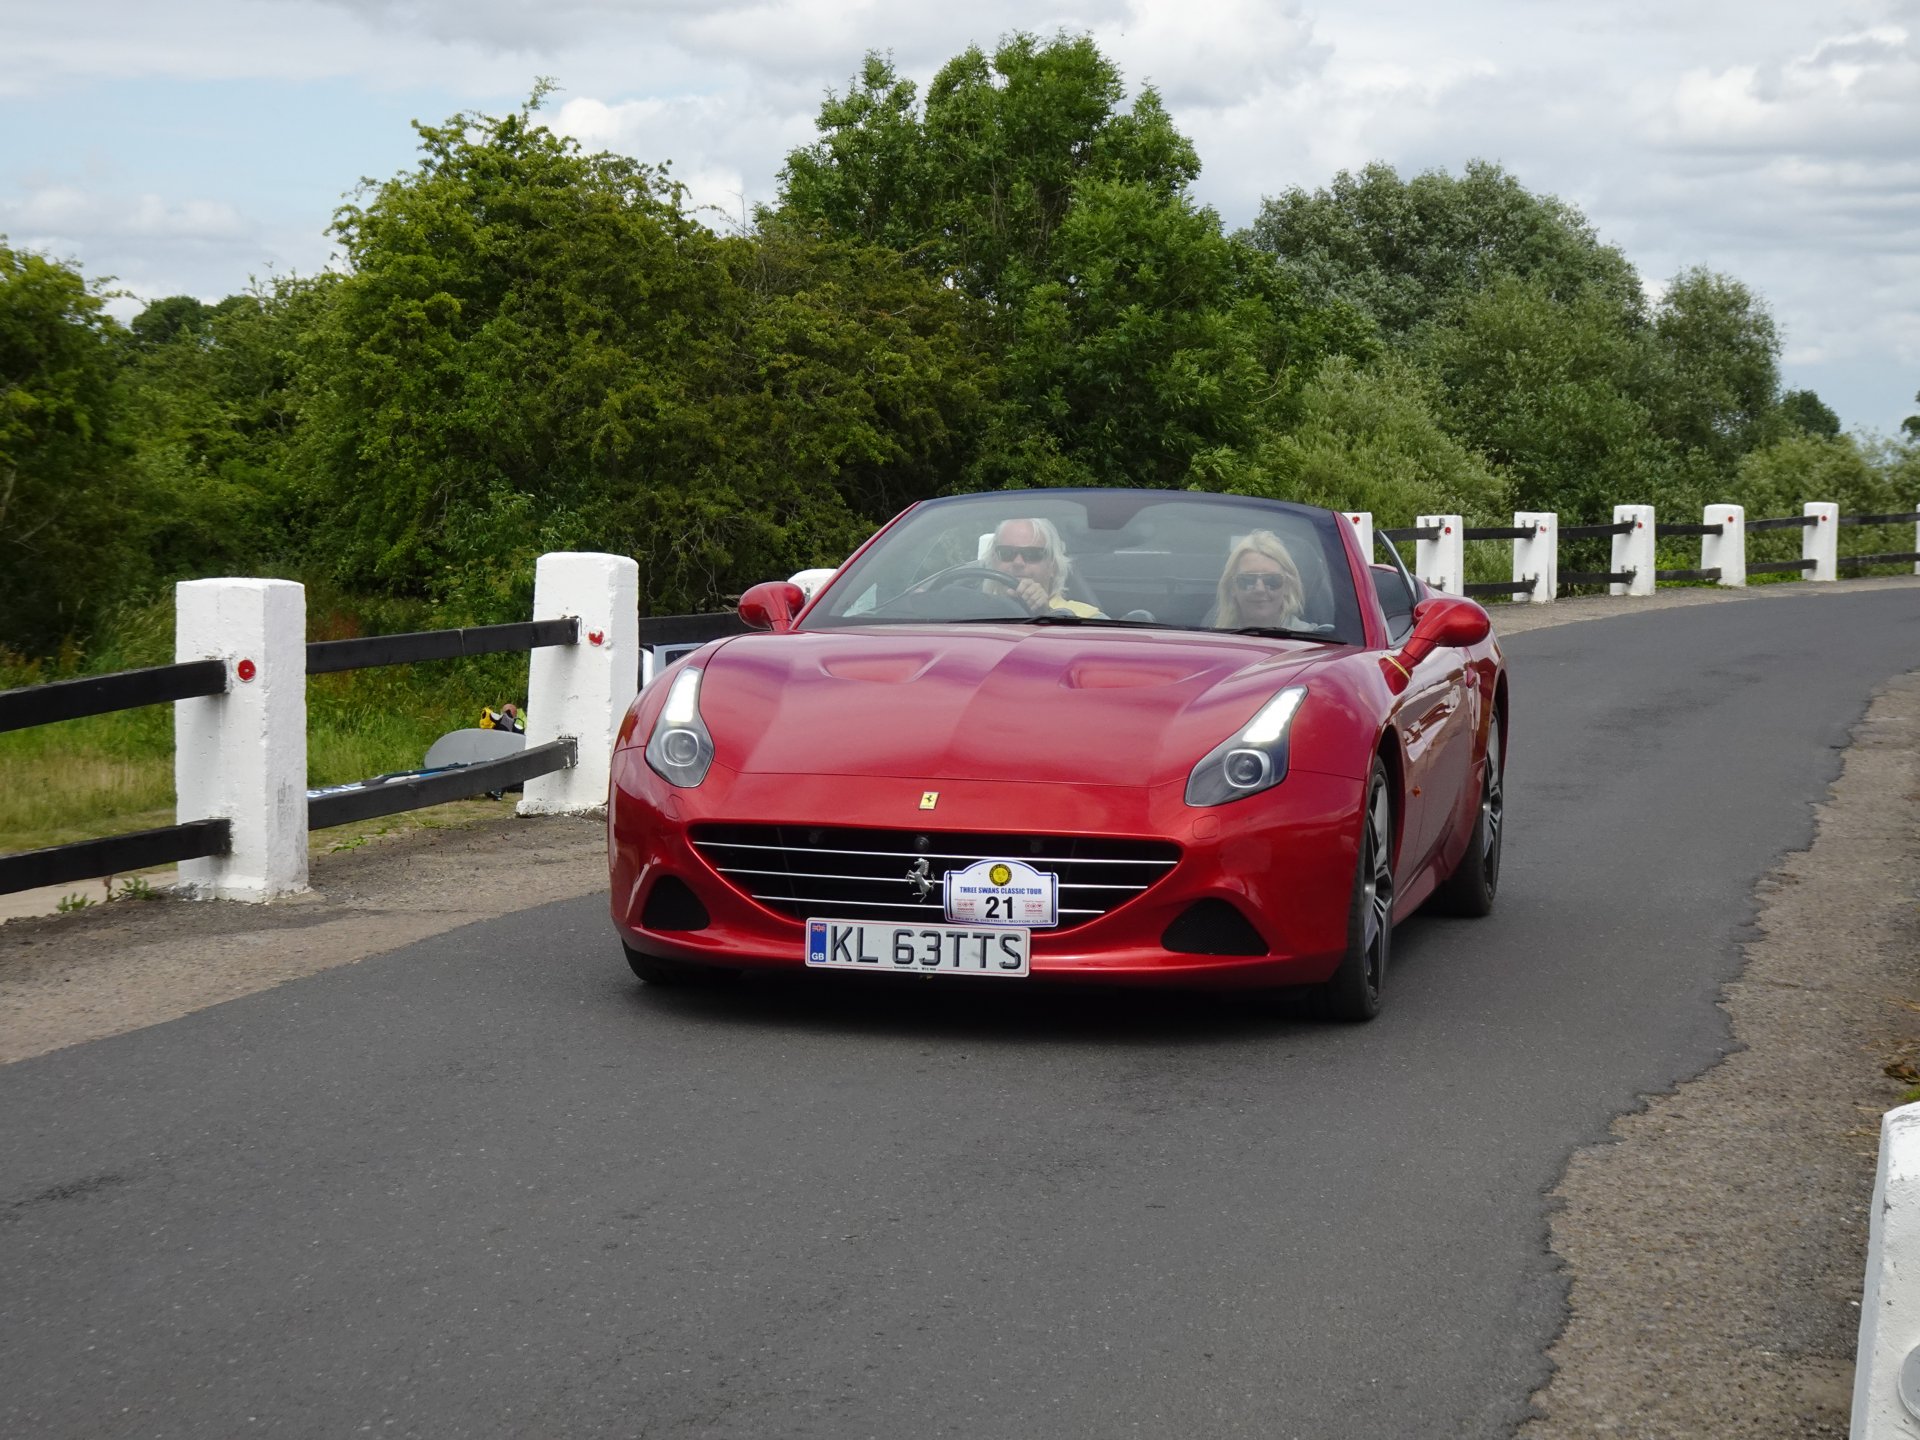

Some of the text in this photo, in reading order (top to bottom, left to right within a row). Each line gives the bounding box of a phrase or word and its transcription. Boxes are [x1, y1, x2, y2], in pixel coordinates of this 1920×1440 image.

[978, 887, 999, 895] SWANS
[1001, 887, 1025, 895] CLASSIC
[985, 896, 1013, 919] 21
[830, 925, 1022, 970] KL 63TTS
[811, 952, 825, 961] GB
